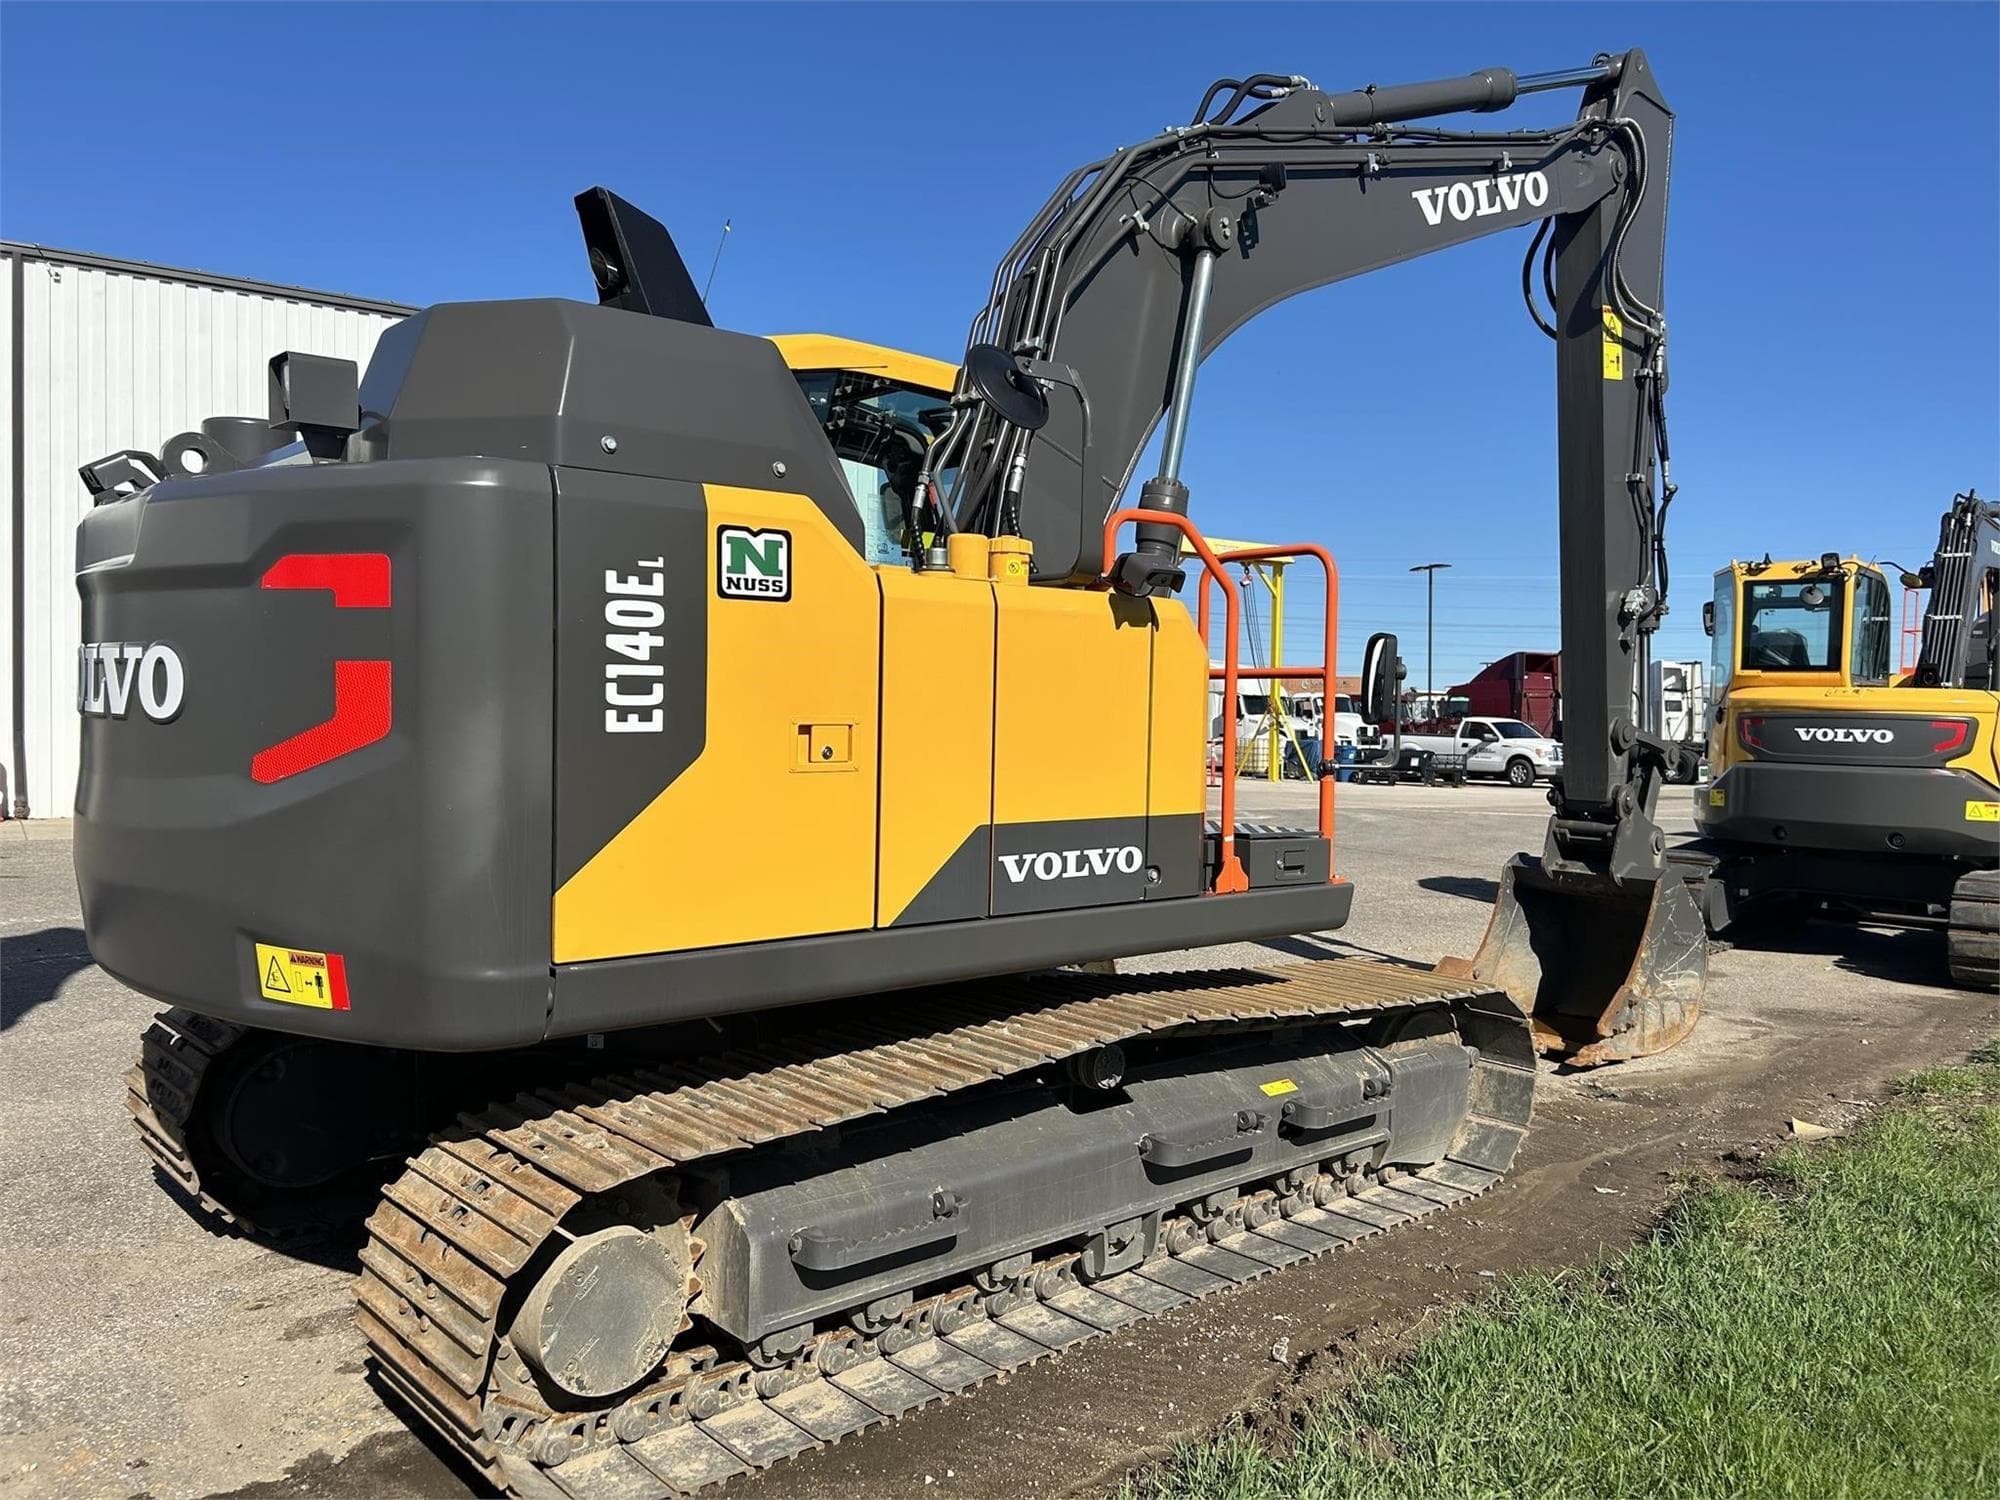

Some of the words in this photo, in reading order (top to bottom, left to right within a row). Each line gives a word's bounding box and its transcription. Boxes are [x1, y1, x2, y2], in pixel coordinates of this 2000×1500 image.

[1412, 171, 1549, 226] VOLVO
[726, 576, 783, 593] NUSS
[79, 643, 184, 719] LVO
[1794, 727, 1894, 744] VOLVO
[998, 846, 1143, 883] VOLVO
